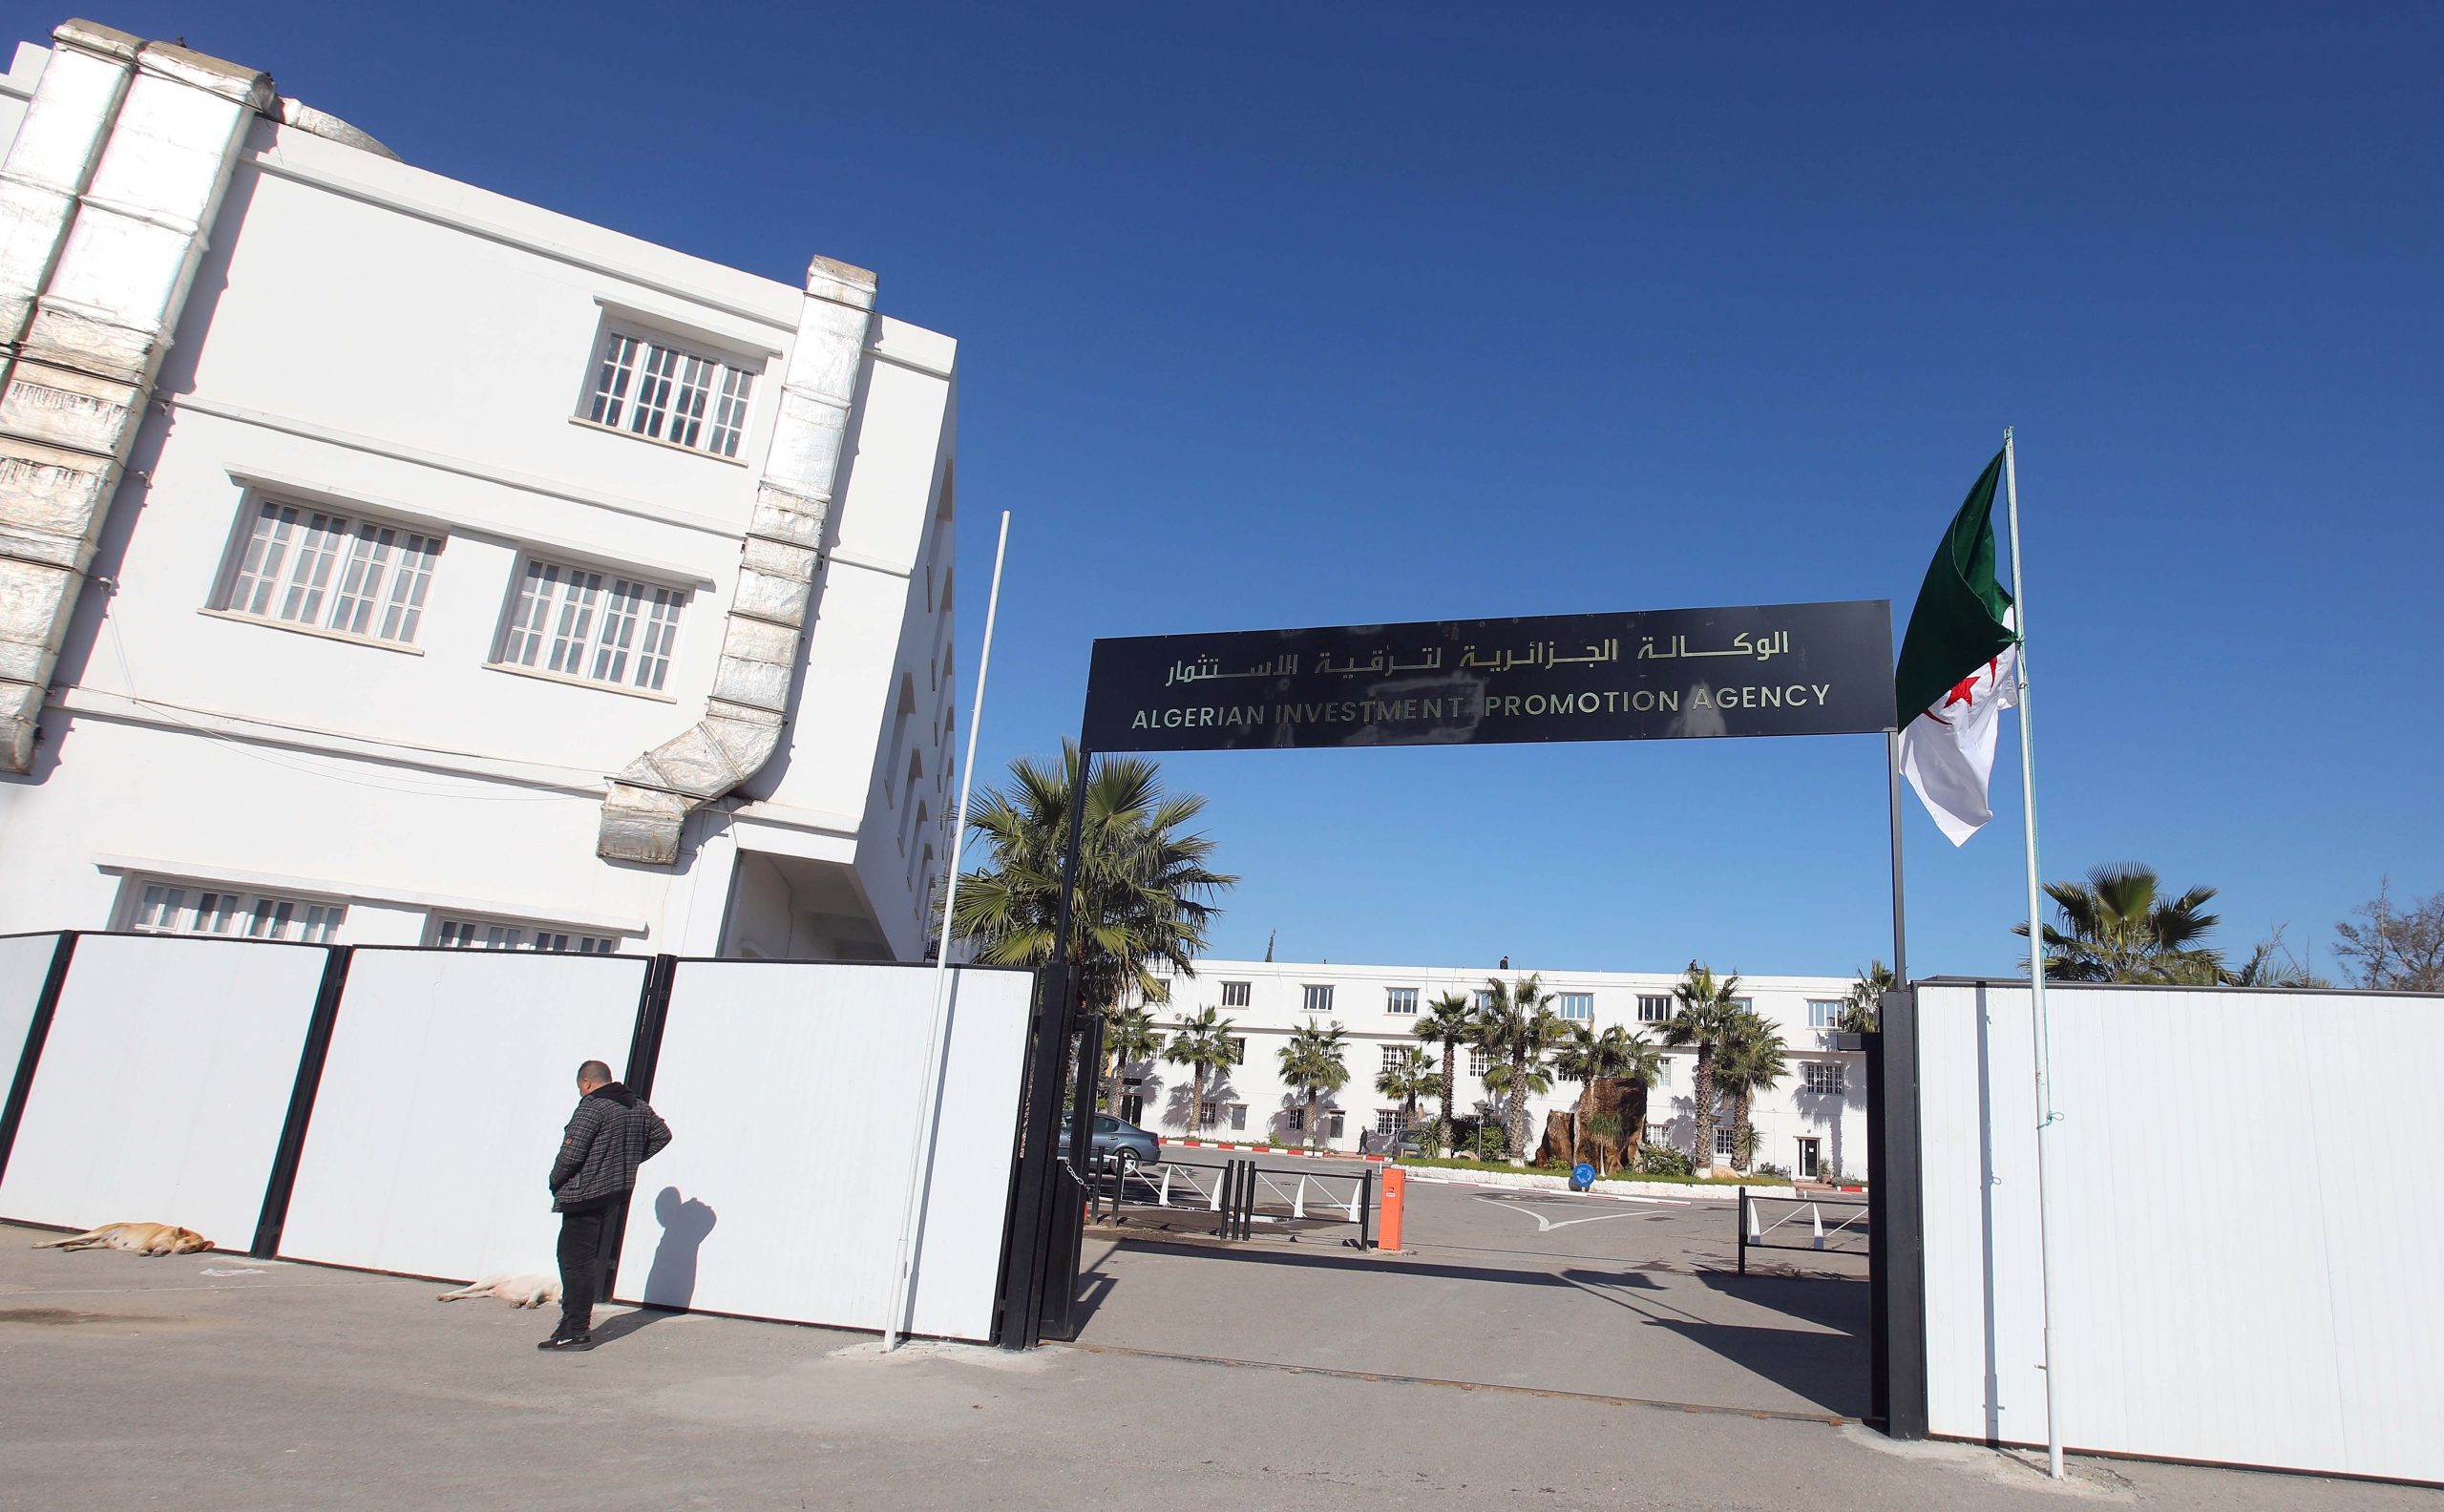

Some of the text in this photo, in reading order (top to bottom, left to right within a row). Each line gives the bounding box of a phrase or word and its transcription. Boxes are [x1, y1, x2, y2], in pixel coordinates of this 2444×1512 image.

[1165, 631, 1789, 687] الوكالة الجزائرية لترقية الاستثمار
[1131, 683, 1831, 730] ALGERIAN INVESTMENT PROMOTION AGENCY
